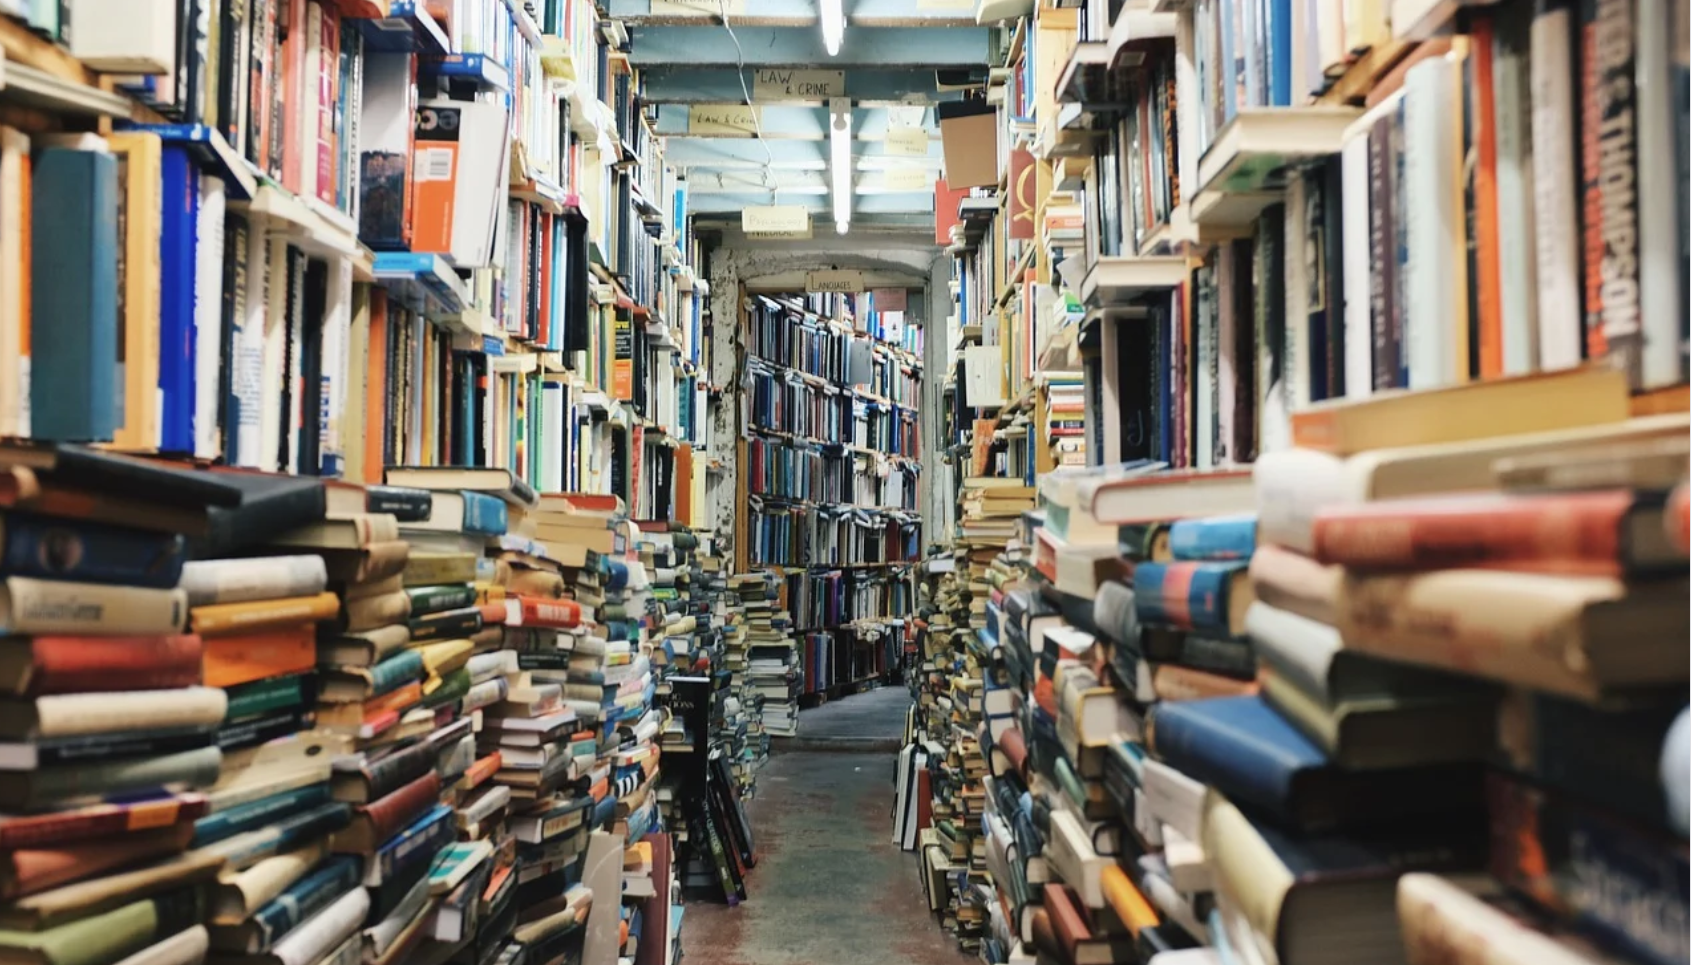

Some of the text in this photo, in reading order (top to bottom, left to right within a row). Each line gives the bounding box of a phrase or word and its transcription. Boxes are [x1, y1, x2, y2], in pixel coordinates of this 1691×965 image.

[760, 70, 794, 84] LAW
[798, 82, 830, 95] CRIME
[697, 113, 720, 123] LAW
[1599, 106, 1641, 337] THOMPSON
